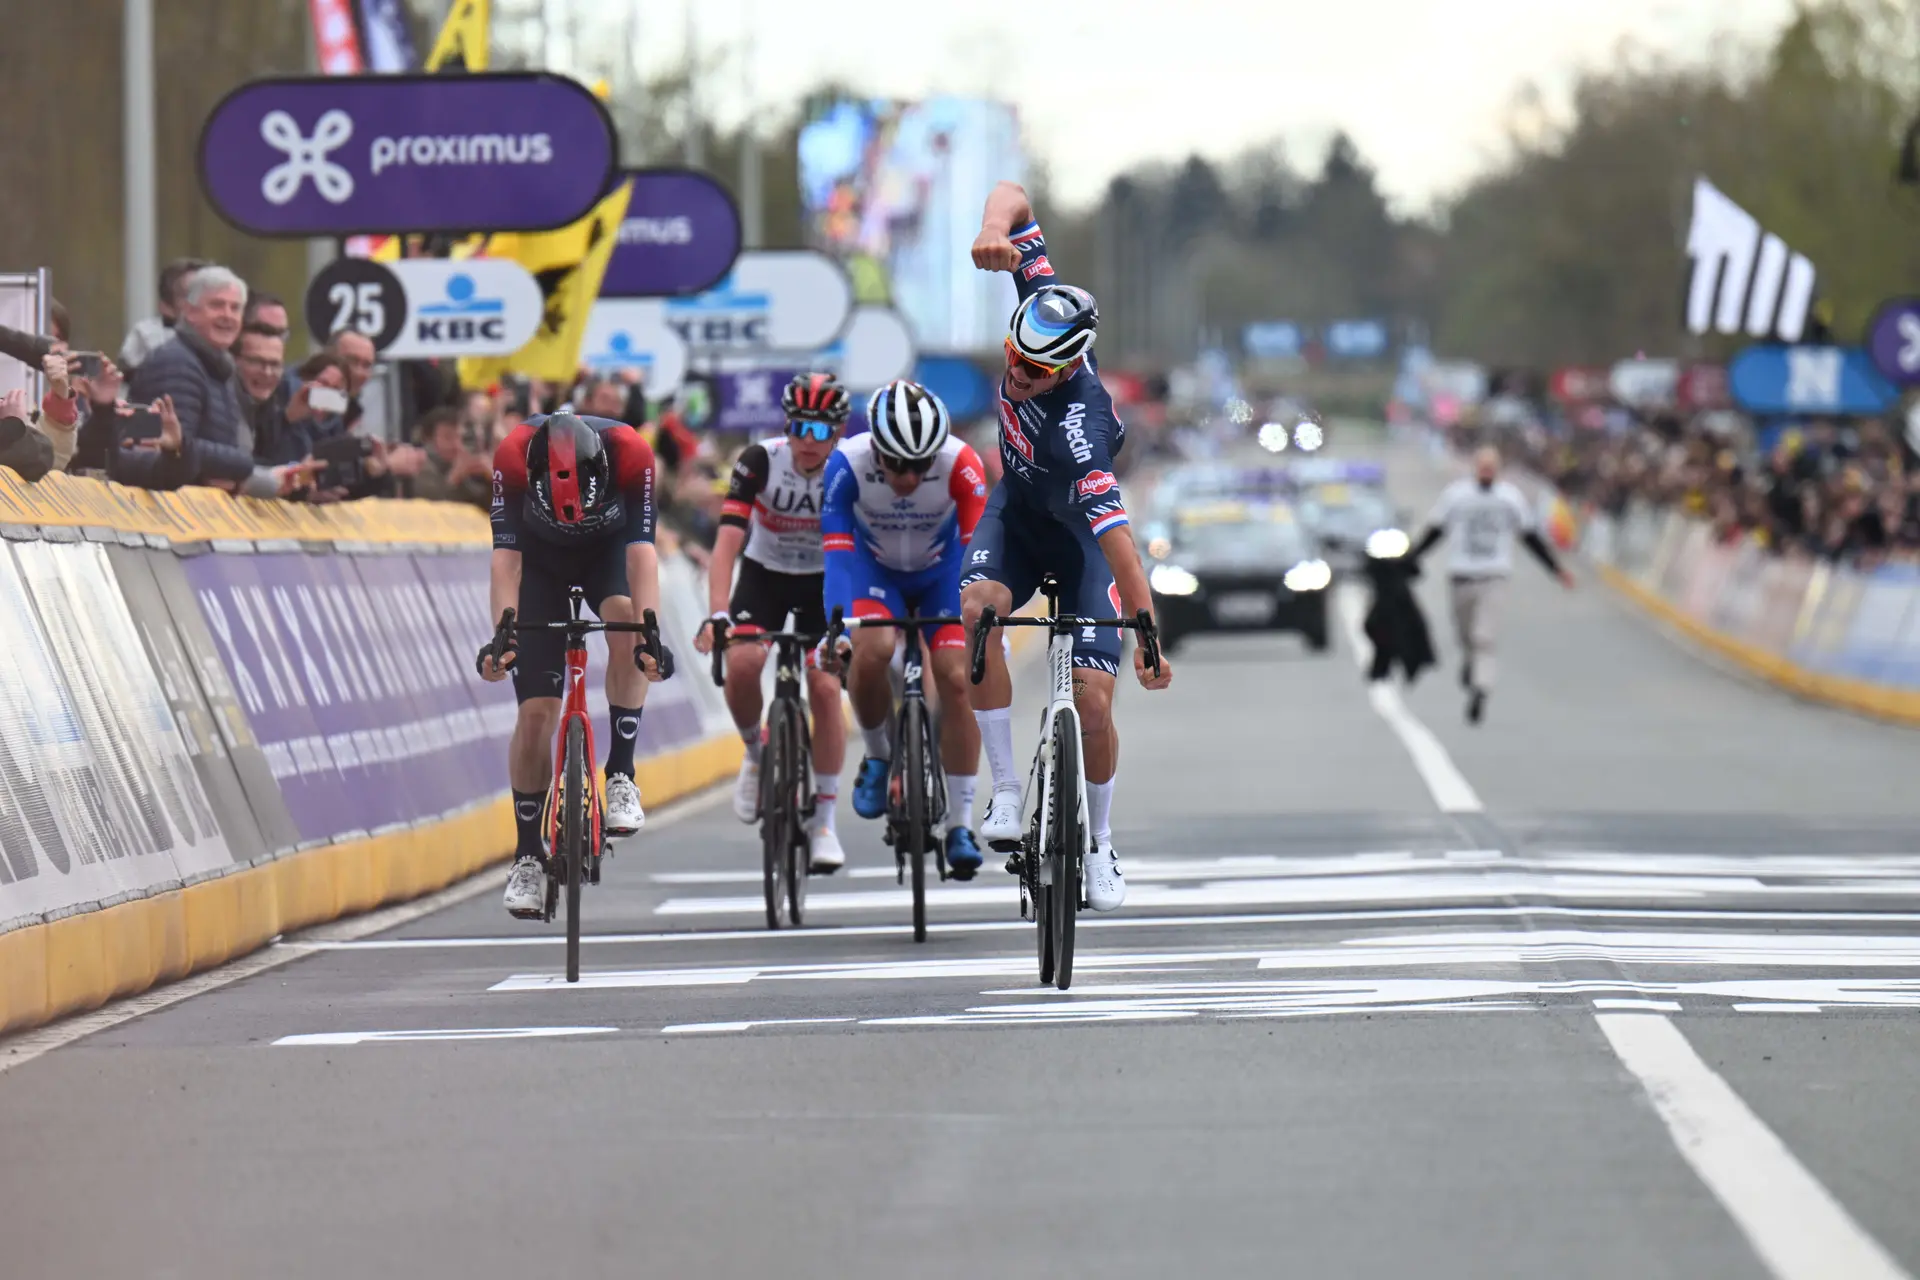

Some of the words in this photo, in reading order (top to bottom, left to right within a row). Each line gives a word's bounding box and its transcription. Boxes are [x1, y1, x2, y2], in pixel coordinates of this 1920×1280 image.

[370, 132, 554, 176] proximus
[329, 283, 385, 335] 25
[417, 317, 506, 342] KBC
[1060, 402, 1094, 464] Alpecin
[490, 469, 506, 522] INEOS
[585, 475, 597, 508] KASK
[642, 467, 652, 533] GRENADIER
[1081, 475, 1115, 492] Alpecin
